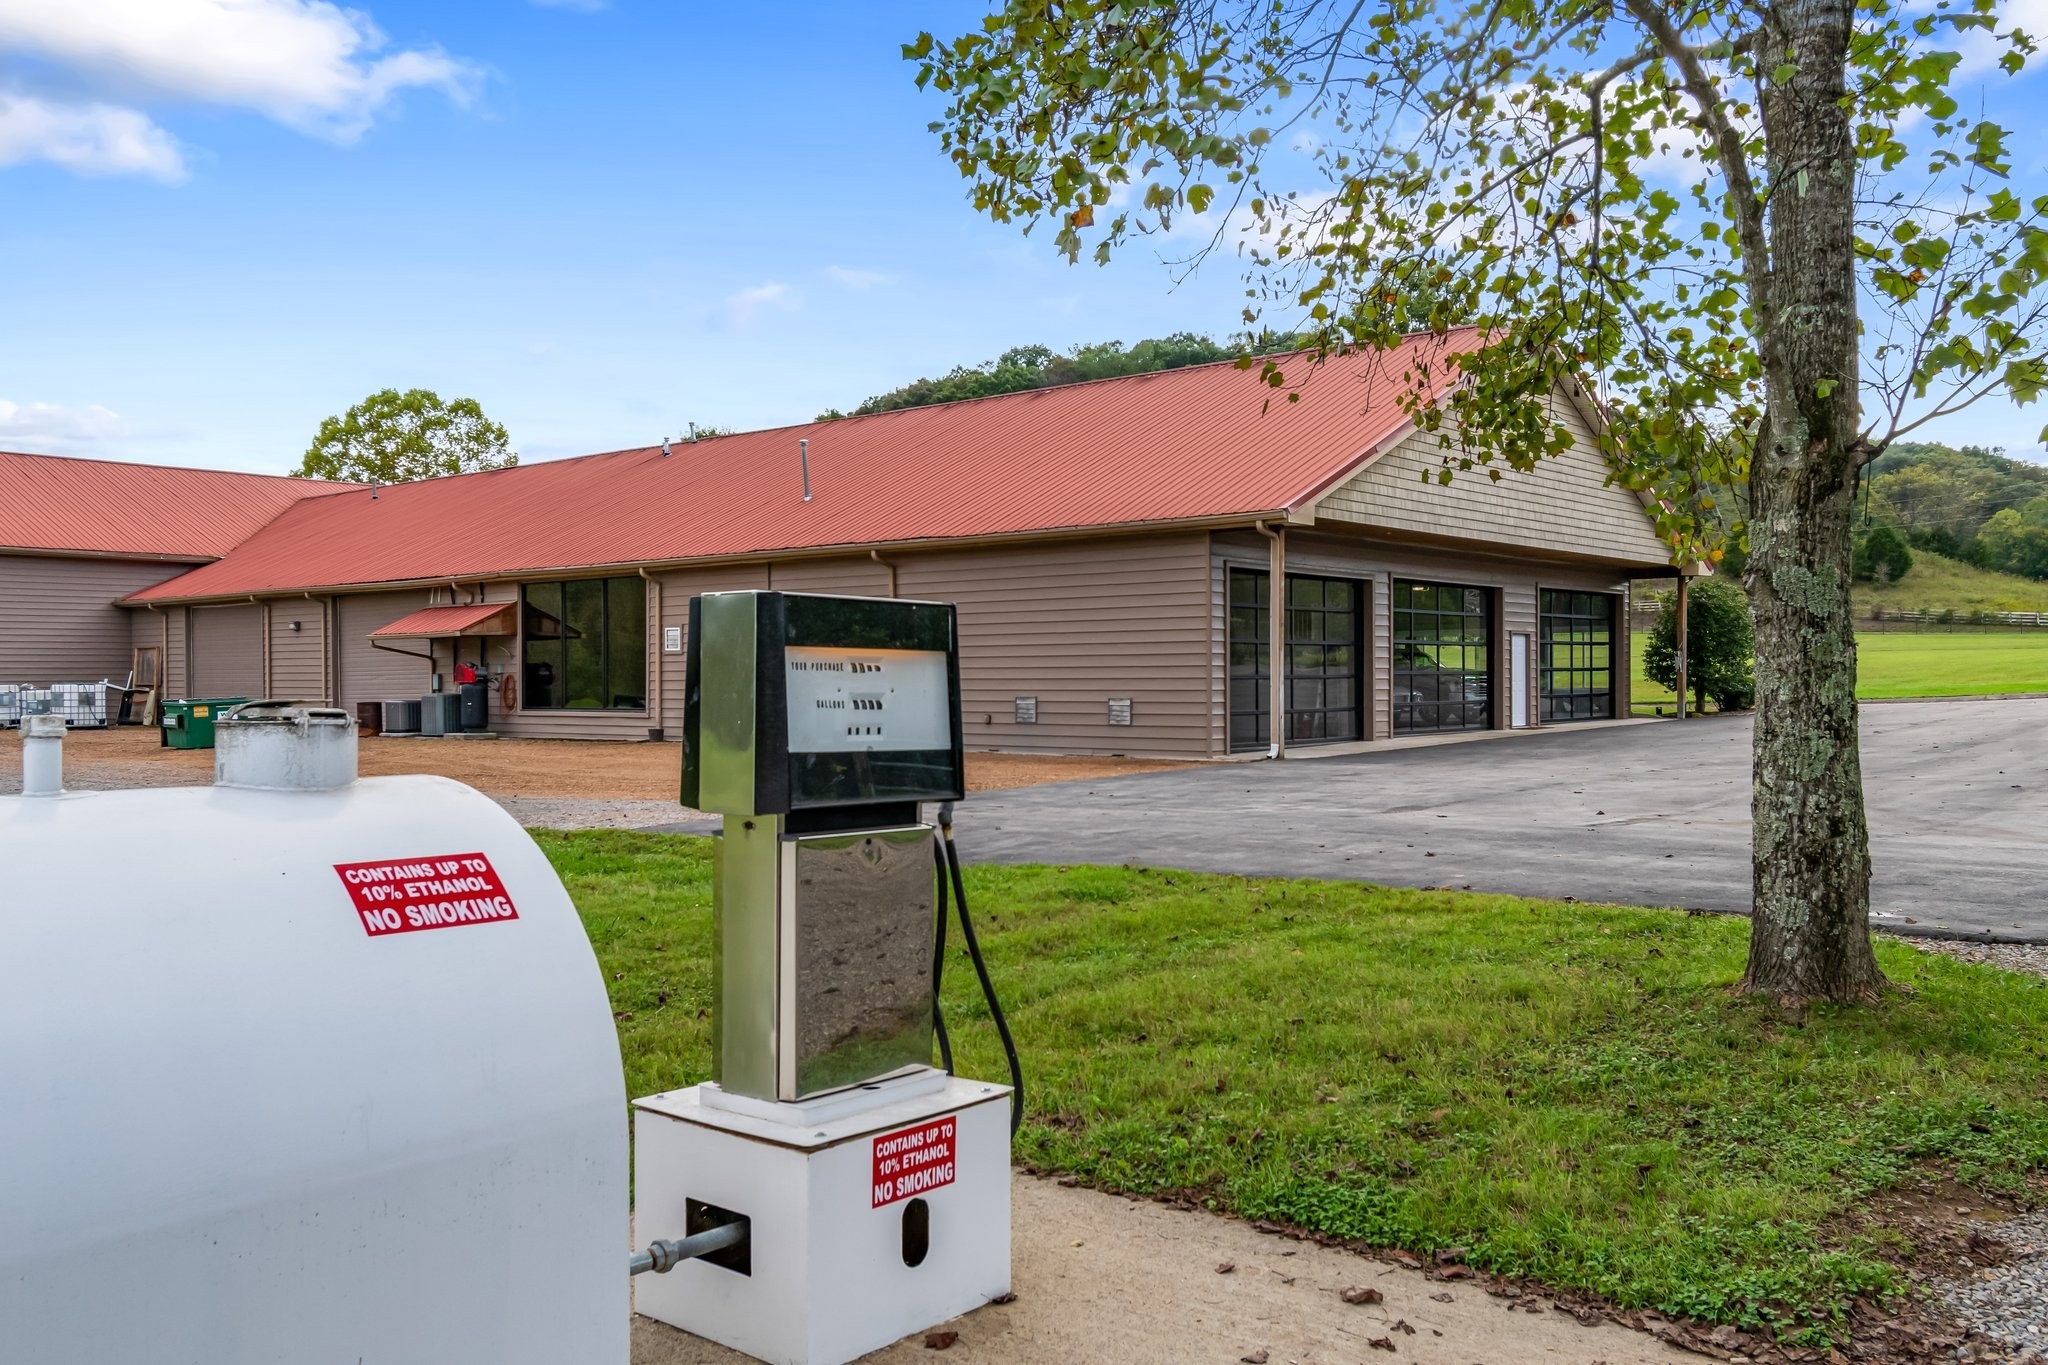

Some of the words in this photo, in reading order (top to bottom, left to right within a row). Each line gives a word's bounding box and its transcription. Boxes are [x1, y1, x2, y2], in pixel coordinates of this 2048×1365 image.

[811, 662, 844, 672] PURCHASE
[817, 700, 845, 709] GALLONS
[345, 863, 435, 884] CONTAINS
[435, 861, 460, 876] UP
[461, 859, 487, 873] TO
[361, 885, 403, 902] 10%
[403, 876, 493, 898] ETHANOL
[363, 908, 402, 931] NO
[405, 896, 513, 927] SMOKING
[876, 1131, 924, 1158] CONTAINS
[926, 1127, 939, 1144] UP
[941, 1123, 953, 1139] TO
[879, 1156, 900, 1176] 10%
[902, 1143, 950, 1169] ETHANOL
[874, 1181, 893, 1204] NO
[896, 1161, 953, 1197] SMOKING
